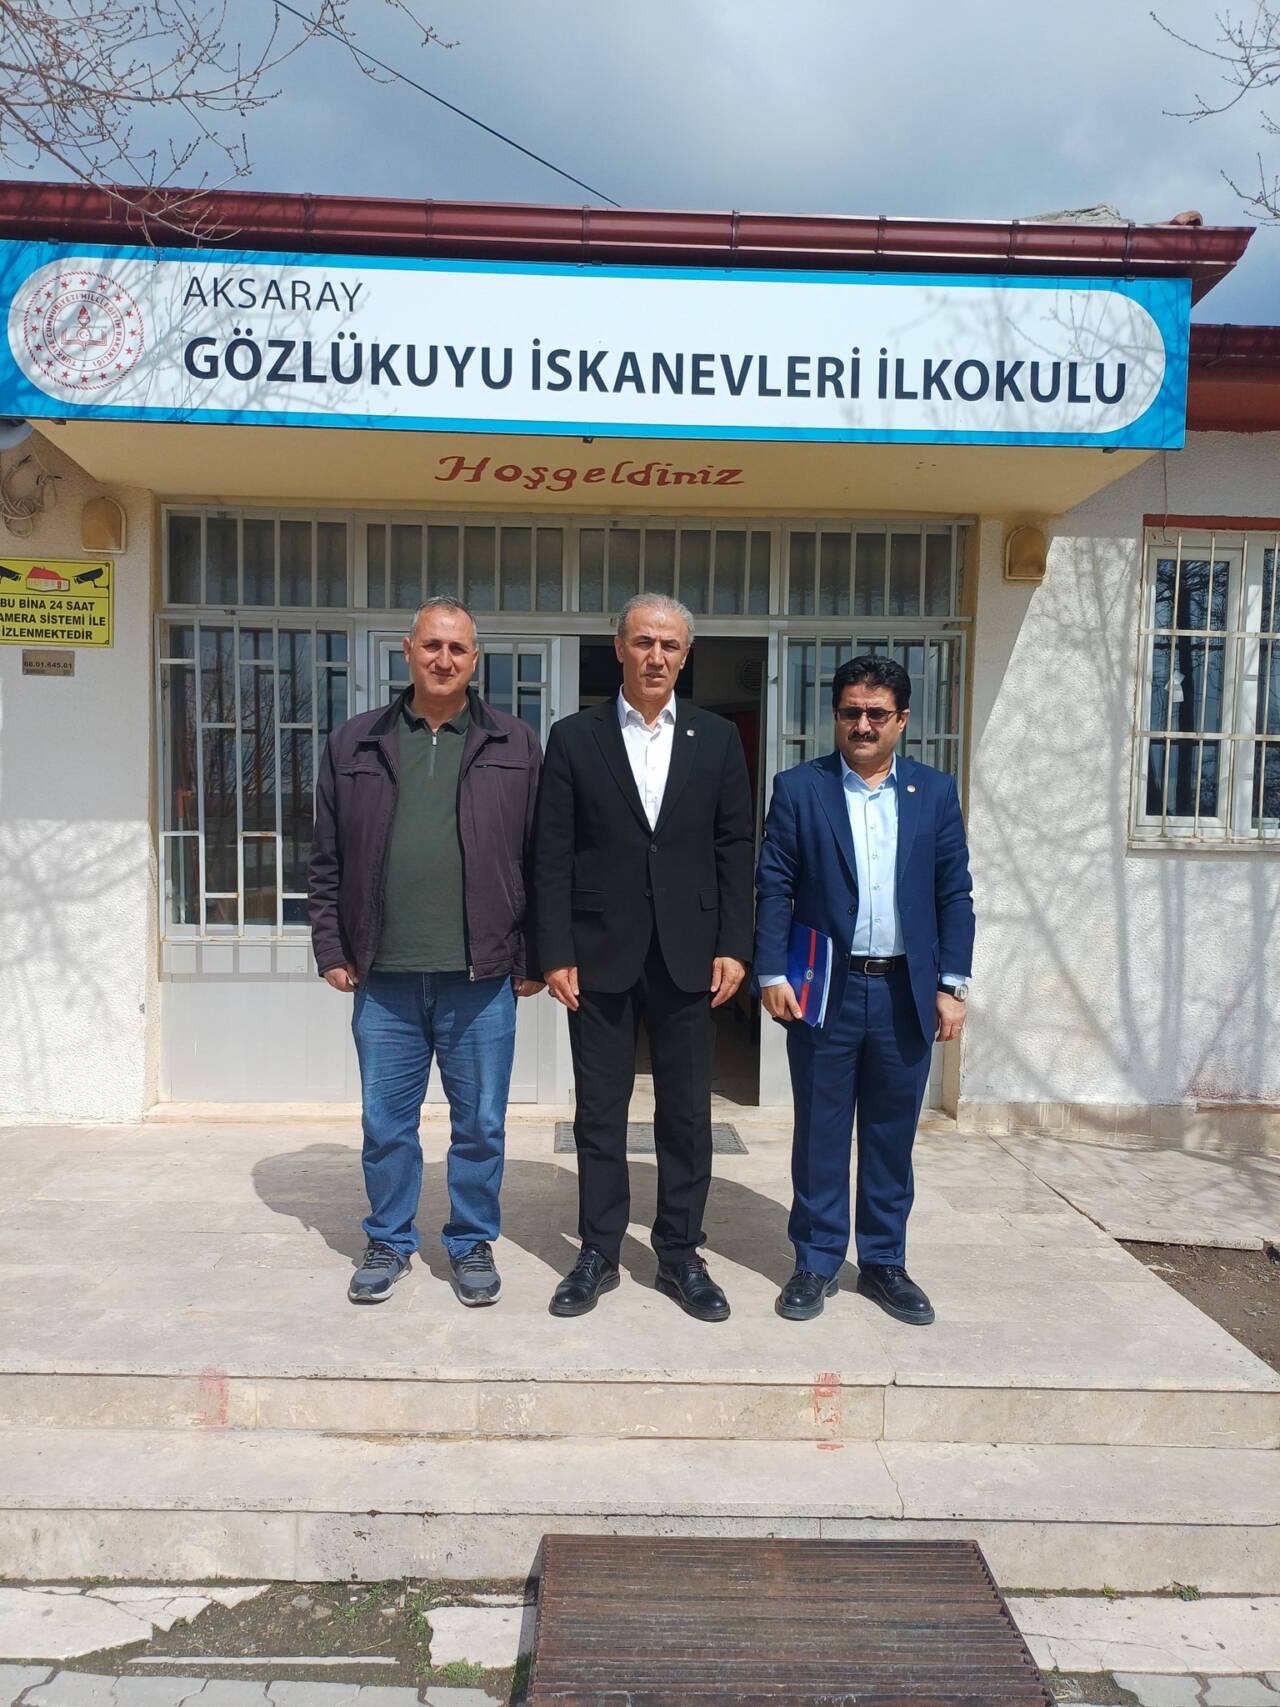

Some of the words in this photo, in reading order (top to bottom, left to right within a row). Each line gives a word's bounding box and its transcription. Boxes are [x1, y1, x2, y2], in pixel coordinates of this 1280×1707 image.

[184, 276, 363, 312] AKSARAY
[185, 328, 513, 390] GÖZLÜKUYU
[532, 339, 860, 399] İSKANEVLERİ
[878, 349, 1126, 404] İLKOKULU
[435, 456, 744, 491] Hoşgeldiniz
[0, 598, 15, 608] BU
[19, 597, 46, 609] BİNA
[50, 600, 62, 610] 24
[66, 600, 95, 611] SAAT
[0, 612, 36, 624] AMERA
[40, 612, 85, 625] SİSTEMİ
[89, 614, 106, 626] İLE
[2, 625, 92, 640] İZLENMEKTEDİR
